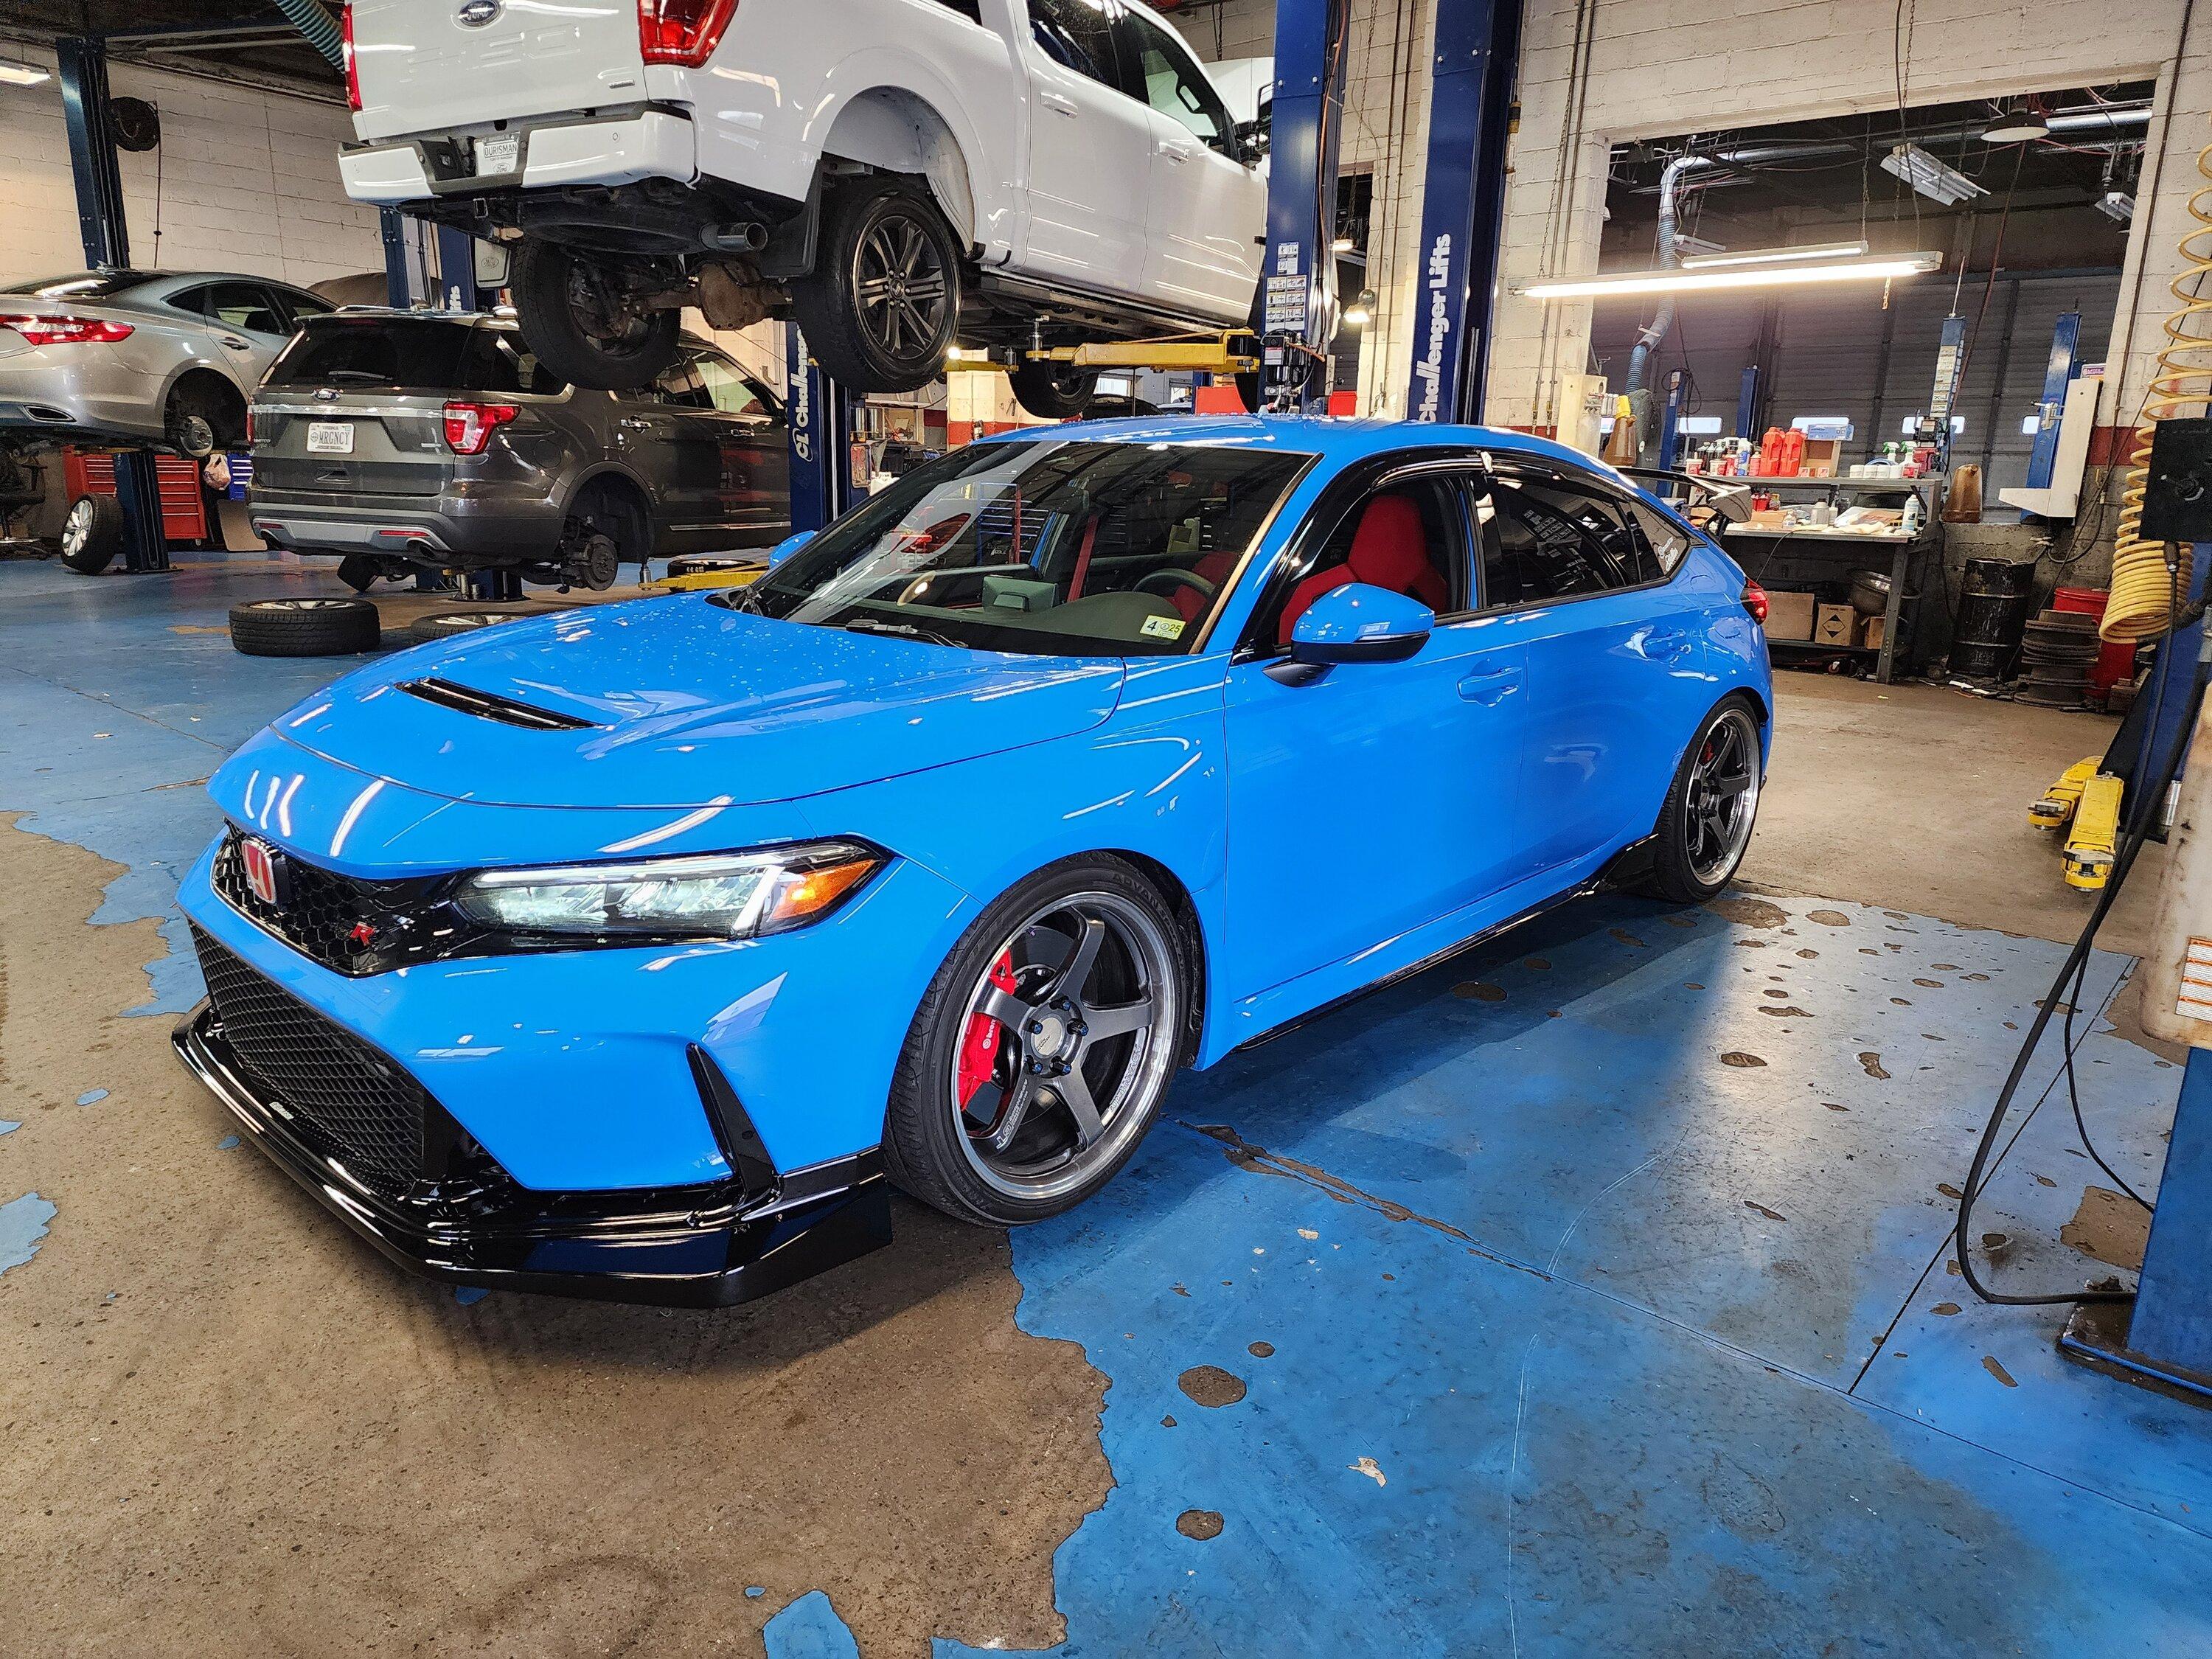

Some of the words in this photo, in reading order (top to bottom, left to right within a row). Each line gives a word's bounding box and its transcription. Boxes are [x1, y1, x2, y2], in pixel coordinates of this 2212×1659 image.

[484, 143, 517, 156] OURISMAN
[1429, 233, 1451, 289] Lifts
[1147, 621, 1158, 631] 4
[1168, 624, 1181, 633] 25
